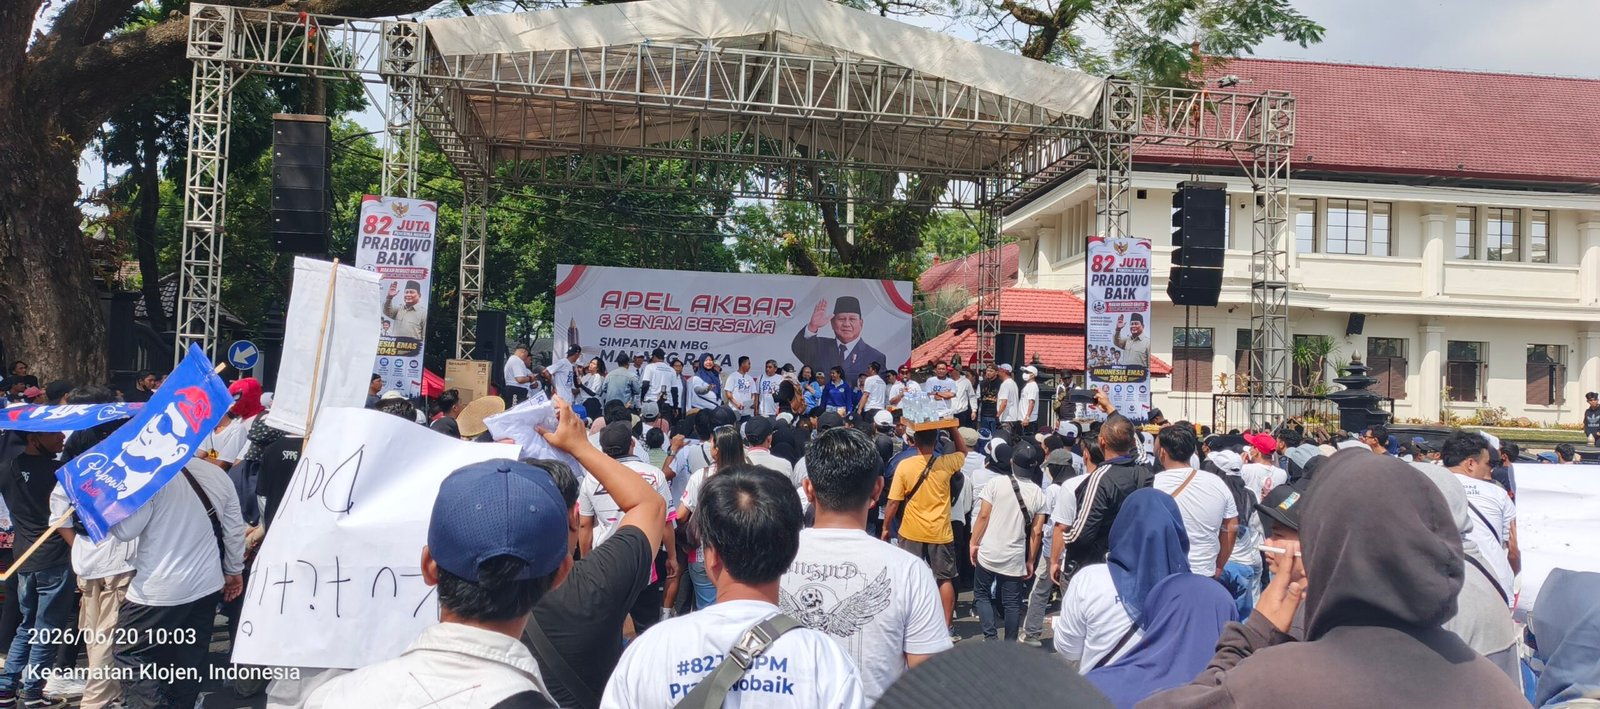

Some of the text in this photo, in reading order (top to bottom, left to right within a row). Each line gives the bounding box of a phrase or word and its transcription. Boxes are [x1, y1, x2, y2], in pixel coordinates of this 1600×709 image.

[363, 215, 430, 235] 82 JUTA
[361, 236, 431, 252] PRABOWO
[376, 251, 415, 266] BAIK
[1091, 254, 1147, 272] 82 JUTA
[1091, 274, 1149, 286] PRABOWO
[1104, 287, 1136, 299] BAIK
[600, 291, 795, 317] APEL AKBAR
[599, 314, 776, 334] & SENAM BERSAMA
[396, 342, 417, 350] EMAS
[599, 337, 709, 351] SIMPATISAN MBG
[282, 450, 298, 461] SPPG
